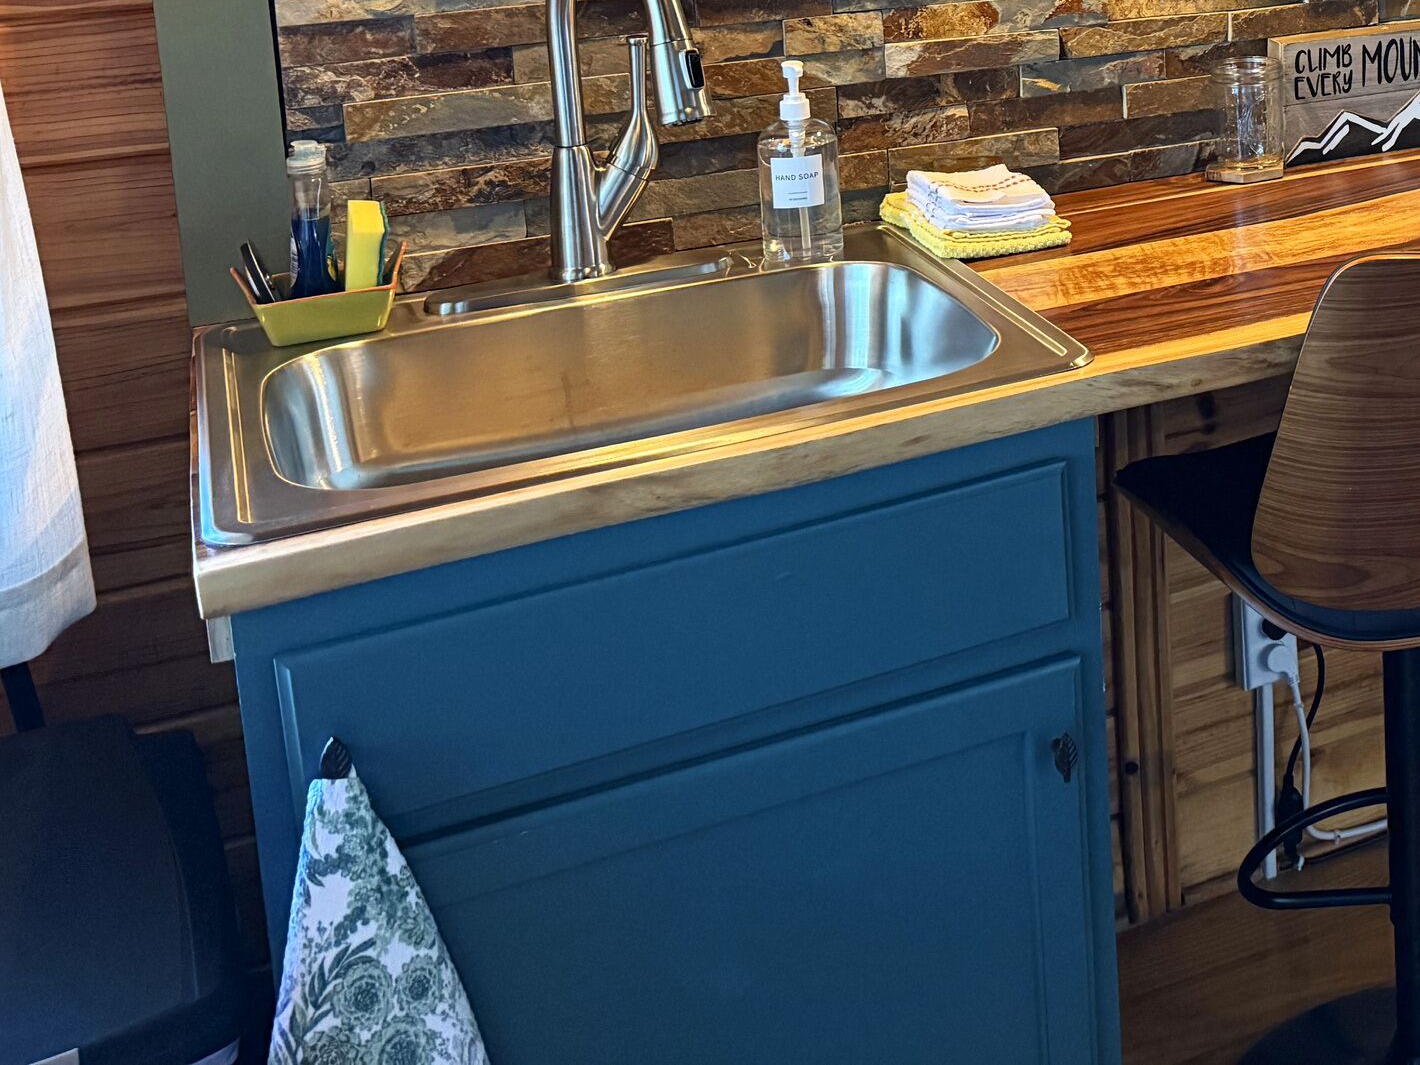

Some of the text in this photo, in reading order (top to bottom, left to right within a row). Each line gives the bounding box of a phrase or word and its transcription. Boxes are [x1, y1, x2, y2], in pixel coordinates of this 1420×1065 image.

[1294, 43, 1352, 74] CLIMB
[1294, 69, 1353, 101] EVERY
[798, 171, 819, 181] SOAP
